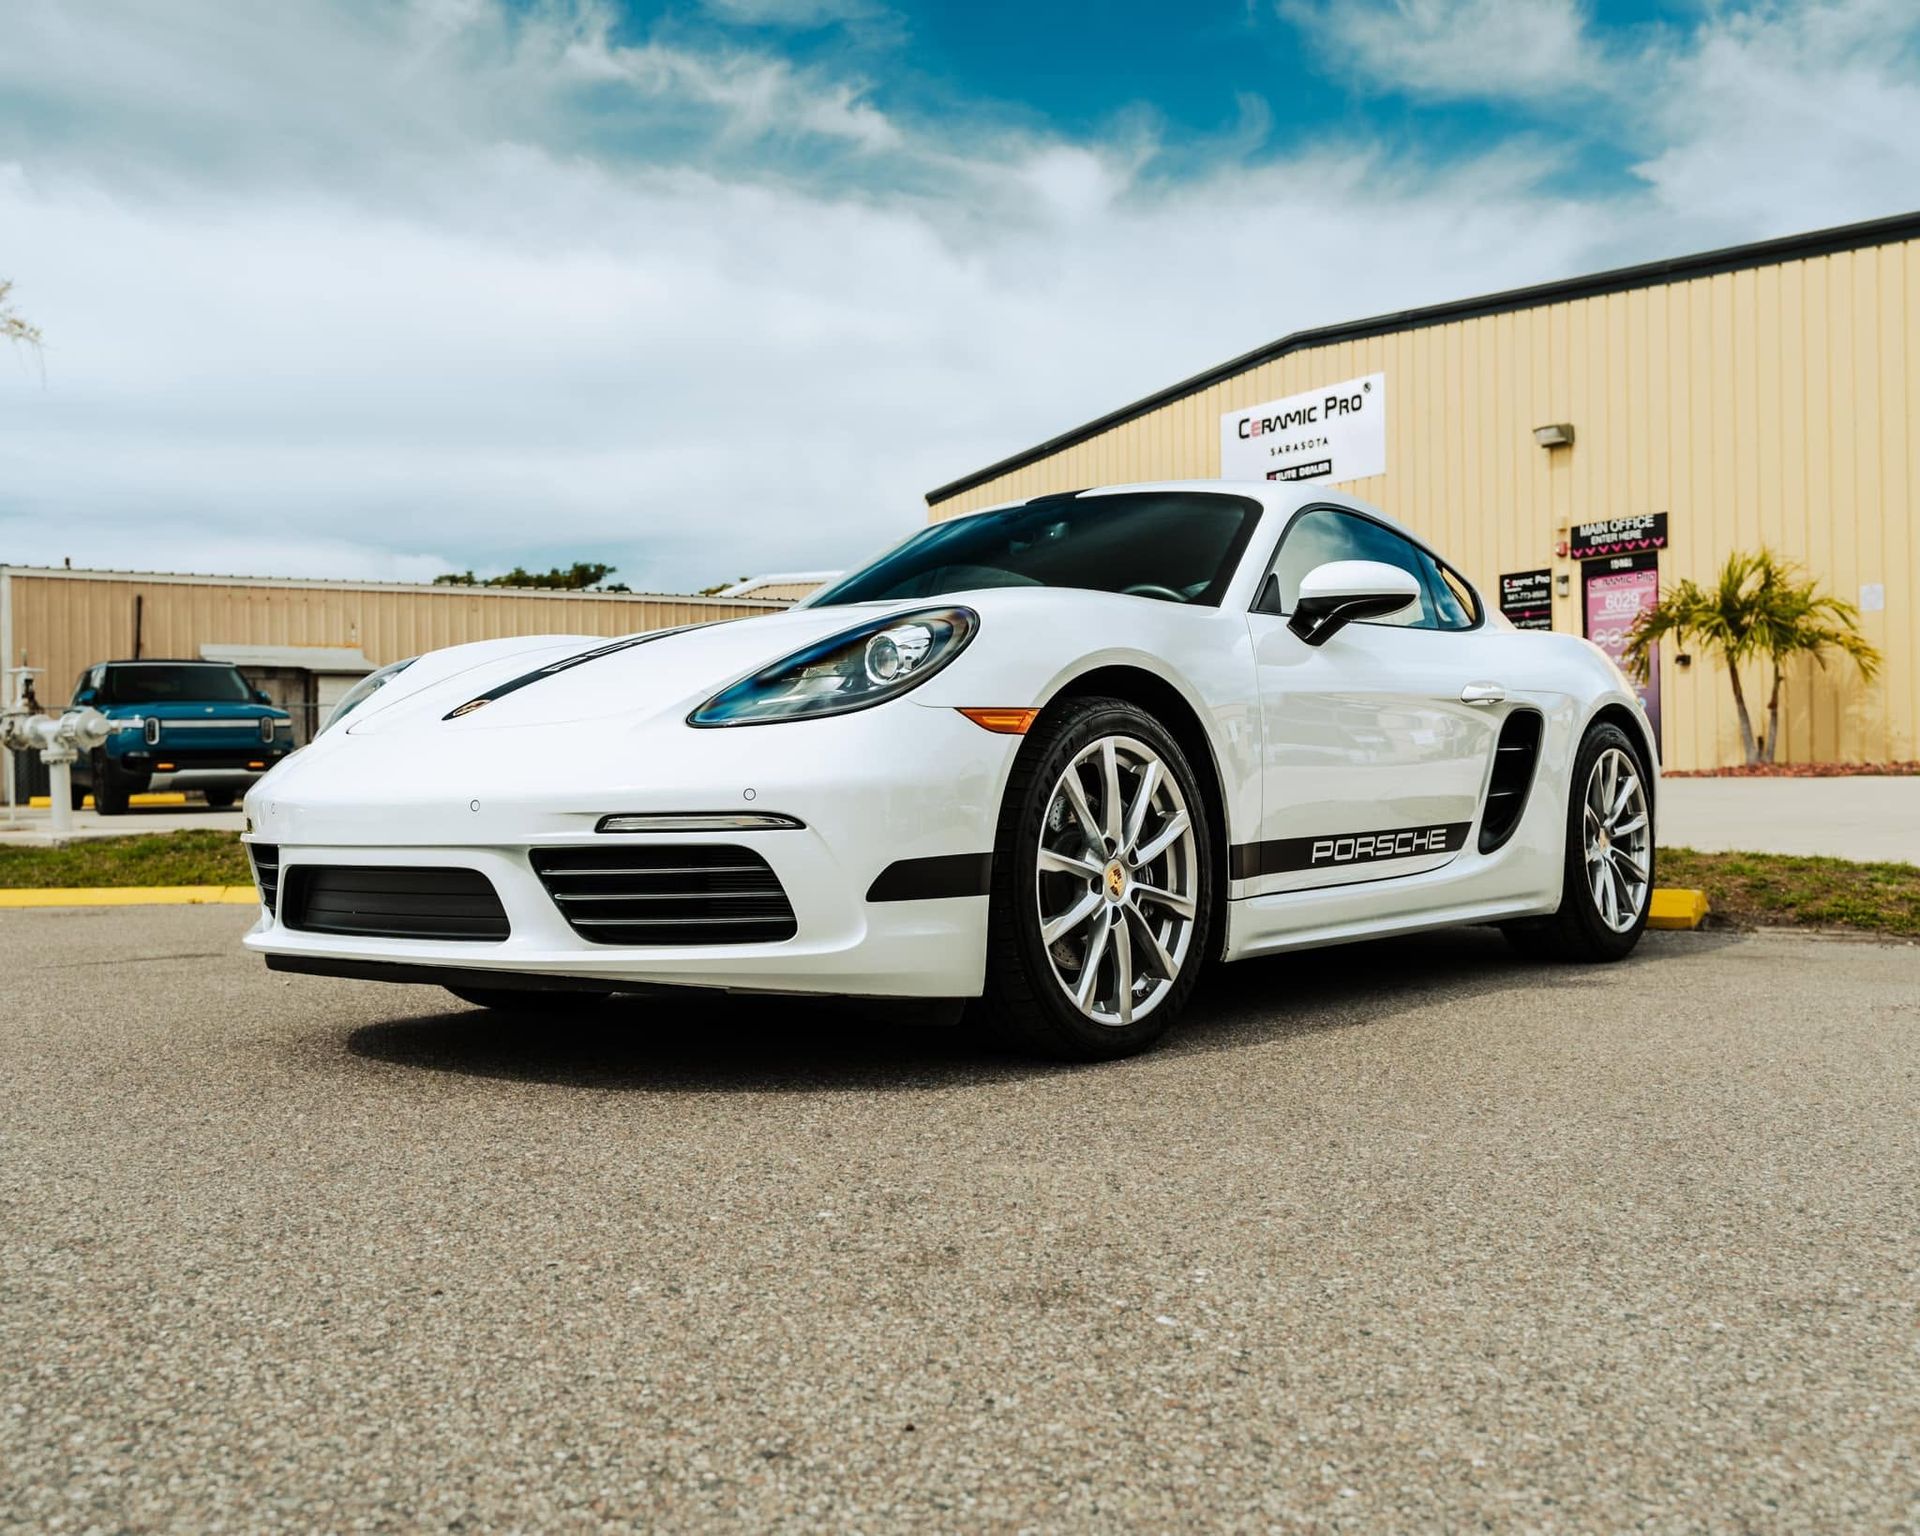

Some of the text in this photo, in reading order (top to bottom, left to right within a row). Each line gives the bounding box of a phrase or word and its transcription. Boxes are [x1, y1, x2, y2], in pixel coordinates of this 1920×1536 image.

[1239, 394, 1362, 439] CERAMIC PRO
[1271, 437, 1329, 456] SARASOTA
[1299, 462, 1330, 477] DEALER
[1580, 514, 1654, 537] MAIN OFFICE
[1590, 529, 1642, 545] ENTER HERE
[1589, 575, 1632, 588] CRAMIC
[1311, 829, 1447, 863] PORSCHE
